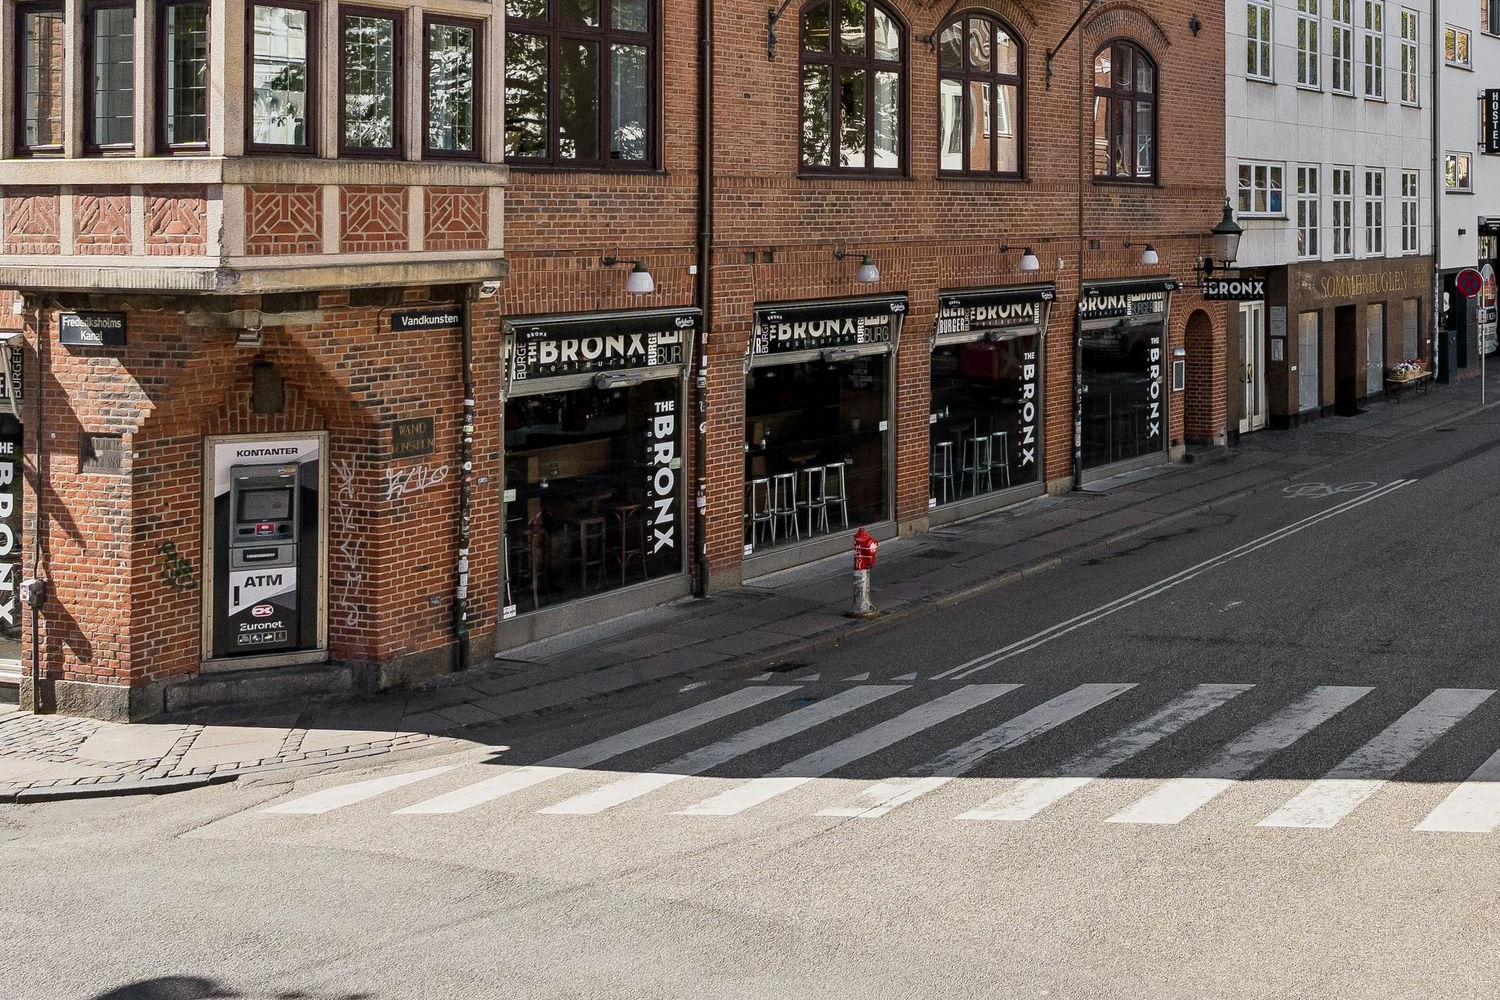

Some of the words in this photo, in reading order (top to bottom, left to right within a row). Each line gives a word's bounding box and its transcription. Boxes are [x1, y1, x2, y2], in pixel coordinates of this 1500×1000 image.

[1208, 282, 1264, 295] BRONX
[62, 315, 122, 329] Frederiksholms
[401, 313, 459, 326] Vandkunsten
[80, 330, 104, 341] Kanal
[778, 317, 856, 340] BRONX
[539, 333, 646, 364] BRONX
[1023, 351, 1035, 360] THE
[539, 355, 646, 373] restaurant
[12, 346, 22, 399] BURGER
[1150, 348, 1160, 438] BRONX
[654, 400, 675, 413] THE
[1022, 363, 1035, 467] BRONX
[236, 447, 298, 457] KONTANTER
[653, 415, 675, 554] BRONX
[244, 574, 282, 588] ATM
[240, 620, 285, 632] Euronet
